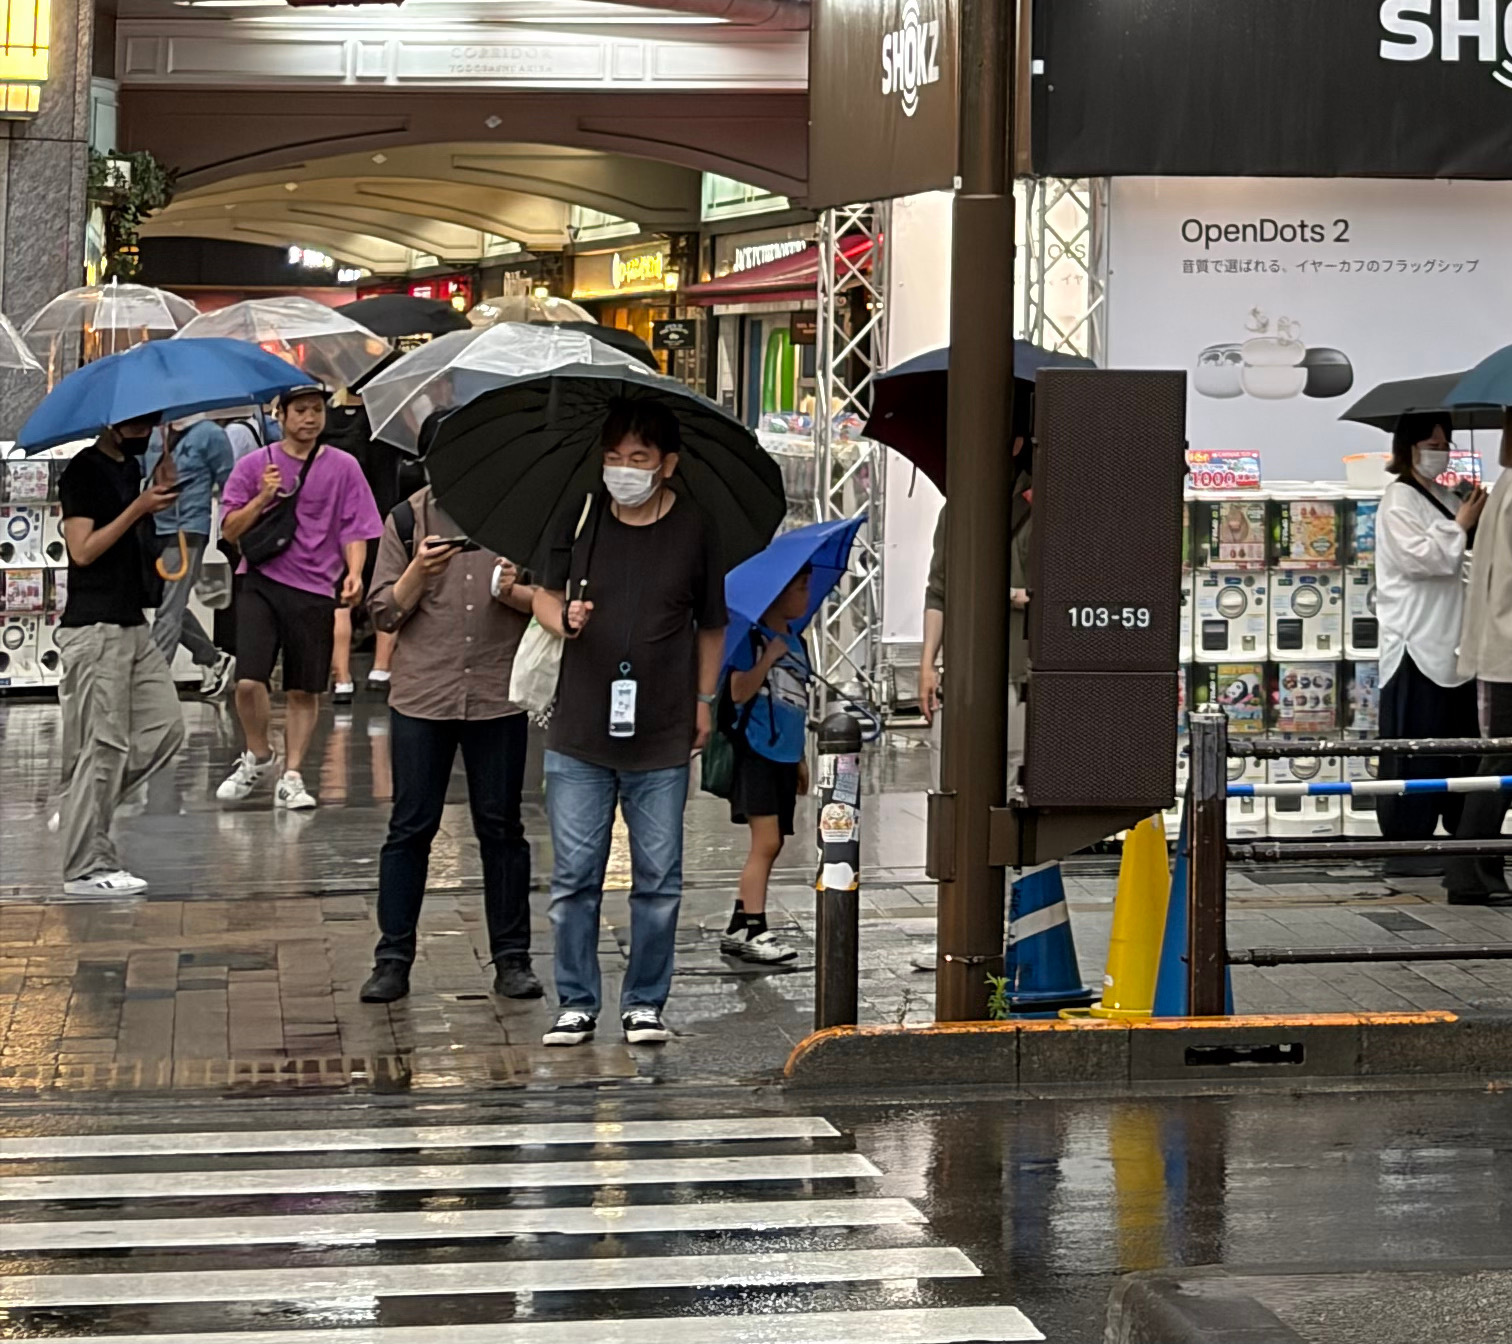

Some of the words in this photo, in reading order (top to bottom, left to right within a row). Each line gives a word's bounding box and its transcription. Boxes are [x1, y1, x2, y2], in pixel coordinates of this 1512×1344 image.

[881, 19, 941, 96] SHOKZ
[1181, 218, 1326, 250] OpenDots
[1332, 218, 1350, 243] 2
[1181, 258, 1480, 274] 音質で選ばれる、イヤーカフのフラッグシップ
[1067, 606, 1152, 630] 103-59
